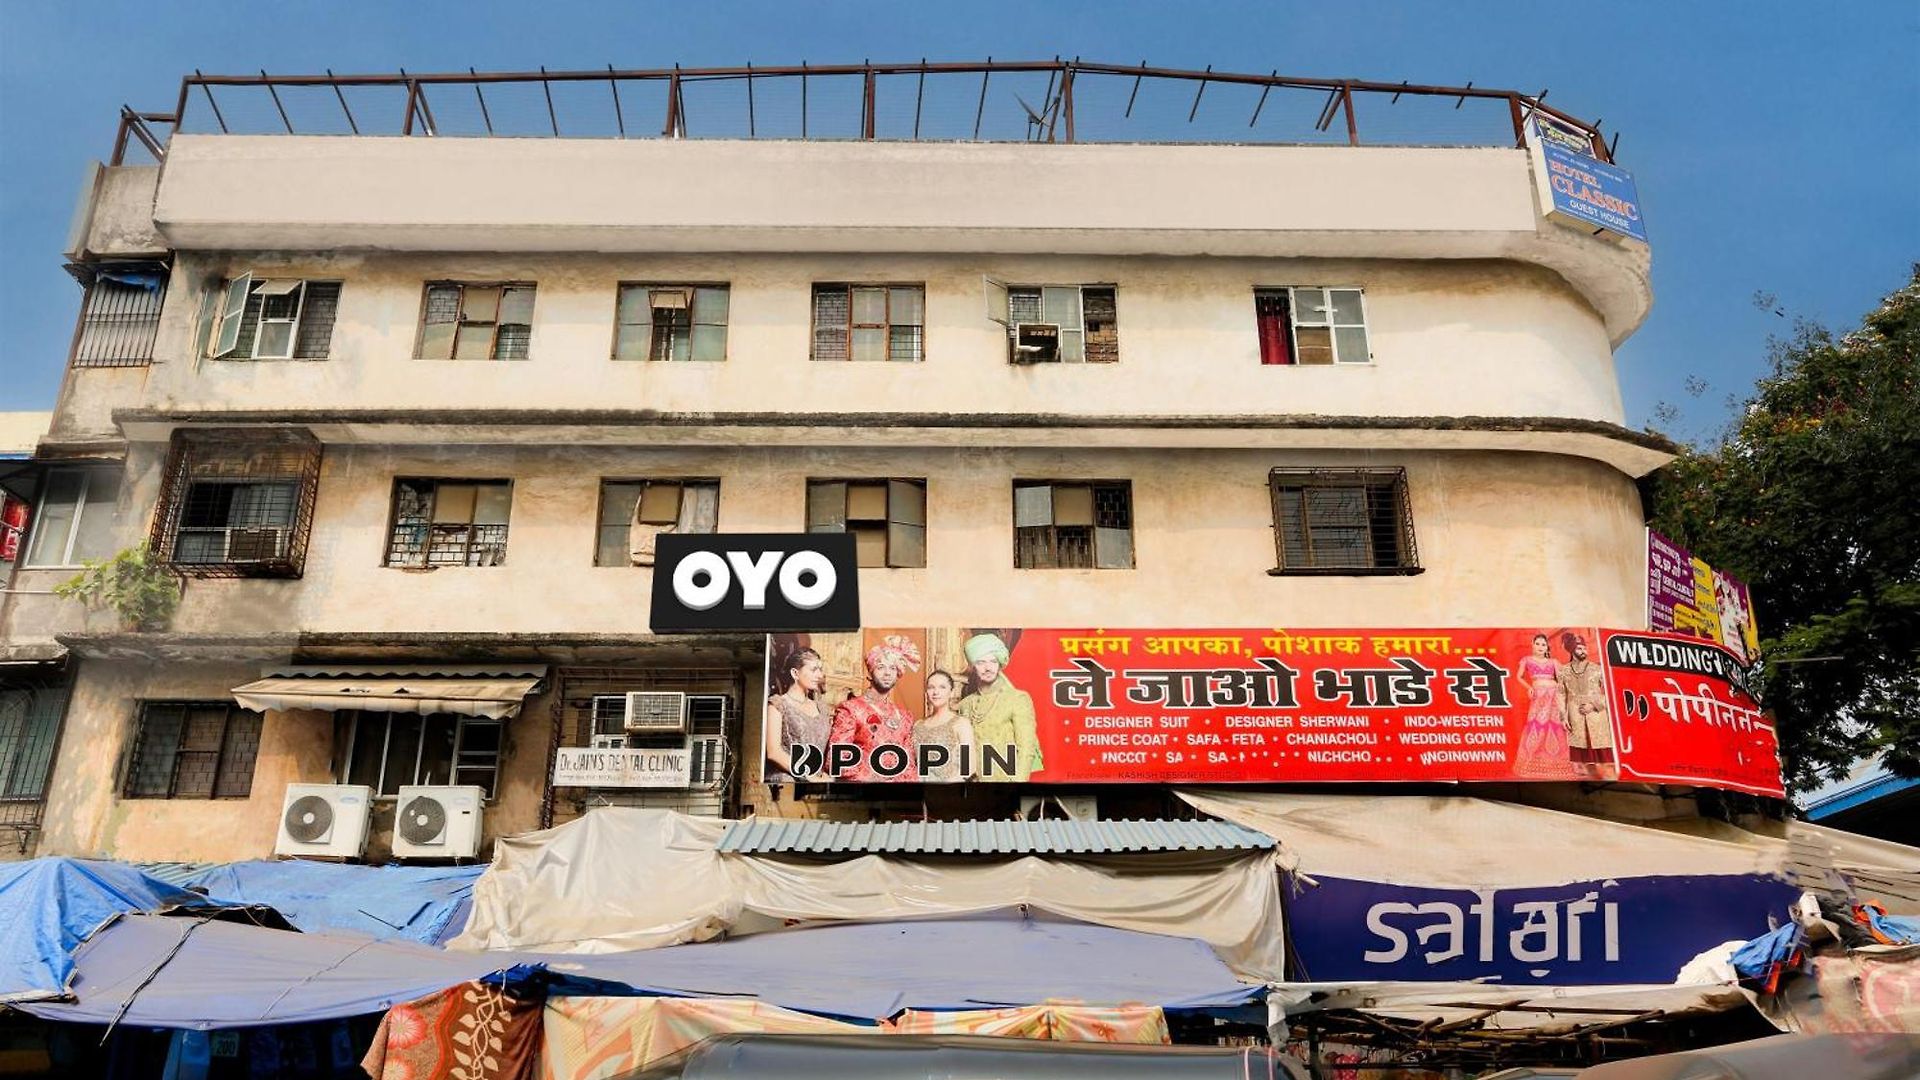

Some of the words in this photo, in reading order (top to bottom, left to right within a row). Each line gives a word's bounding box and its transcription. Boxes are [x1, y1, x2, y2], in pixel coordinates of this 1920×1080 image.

[1551, 160, 1602, 189] HOTEL
[1551, 174, 1638, 221] CLASSIC
[1569, 199, 1598, 218] GUEST
[1600, 212, 1630, 229] HOUSE
[672, 549, 838, 612] OYO
[1059, 628, 1132, 656] प्रसंग
[1261, 628, 1364, 656] पोशाक
[1049, 657, 1116, 709] ले
[1123, 657, 1301, 709] जाओ
[1444, 656, 1513, 708] से
[1084, 716, 1153, 729] DESIGNER
[1159, 716, 1190, 728] SUIT
[1225, 716, 1293, 728] DESIGNER
[1299, 715, 1370, 728] SHERWANI
[1404, 715, 1504, 728] INDO-WESTERN
[1078, 734, 1128, 746] PRINCE
[1132, 733, 1169, 746] COAT
[1187, 733, 1221, 746] SAFA
[1232, 733, 1265, 745] FETA
[1286, 732, 1378, 746] CHANIACHOLI
[1399, 732, 1462, 745] WEDDING
[1464, 732, 1507, 745] GOWN
[648, 753, 685, 773] CLINIC
[830, 743, 1018, 777] POPIN
